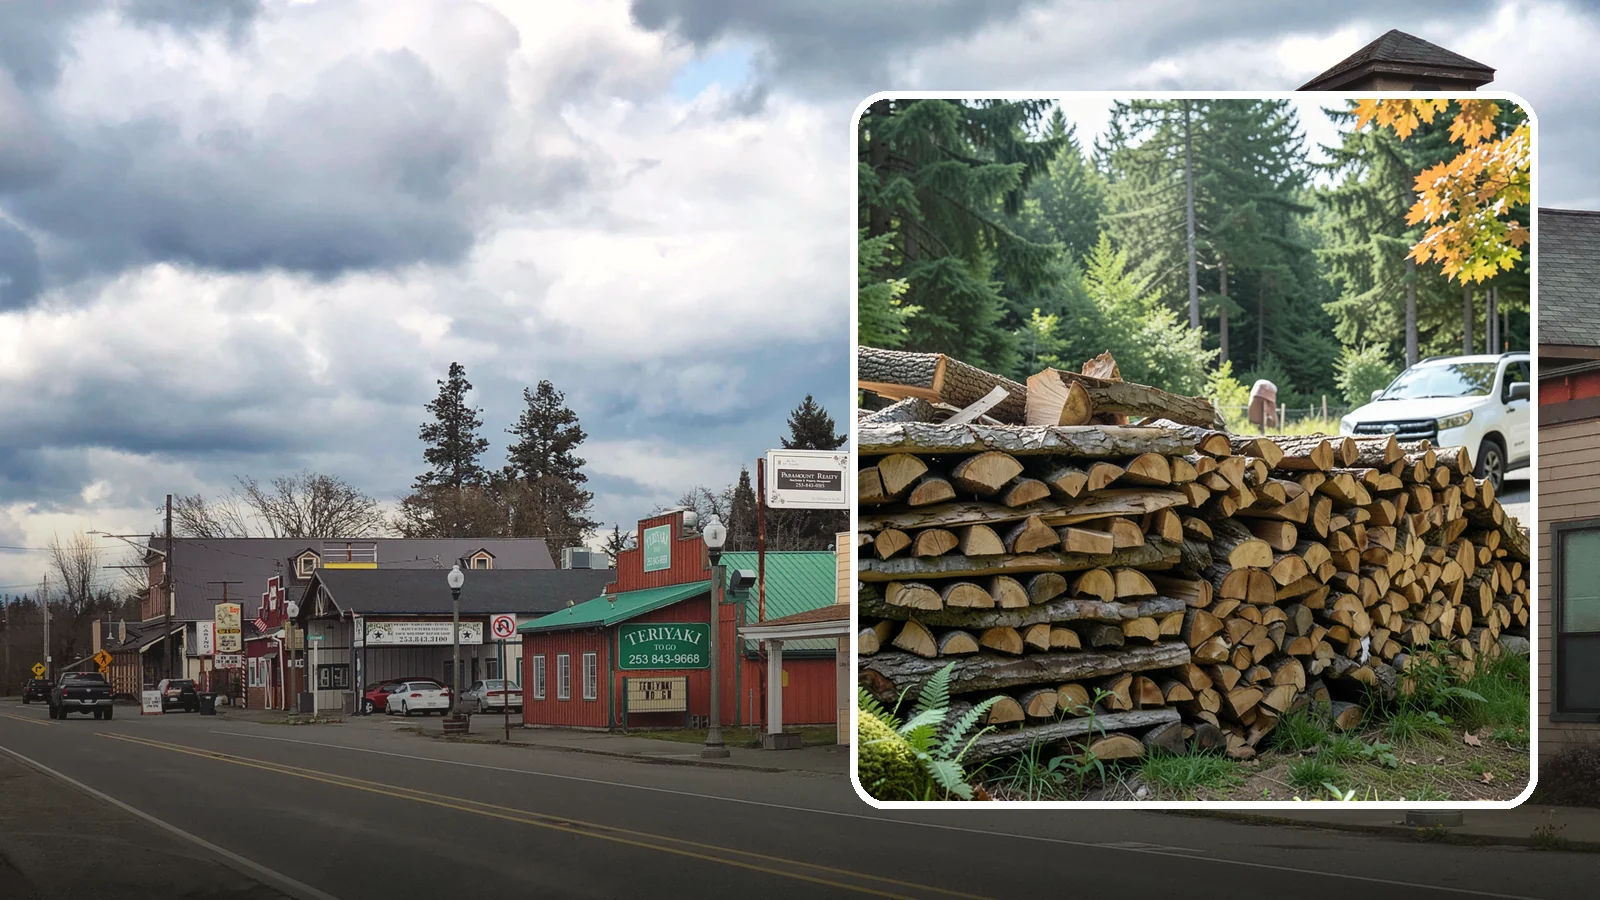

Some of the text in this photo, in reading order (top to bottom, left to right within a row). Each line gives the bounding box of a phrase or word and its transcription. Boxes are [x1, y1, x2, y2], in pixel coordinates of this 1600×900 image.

[624, 627, 702, 646] TERIYAKI
[629, 654, 700, 665] 253 843-9668
